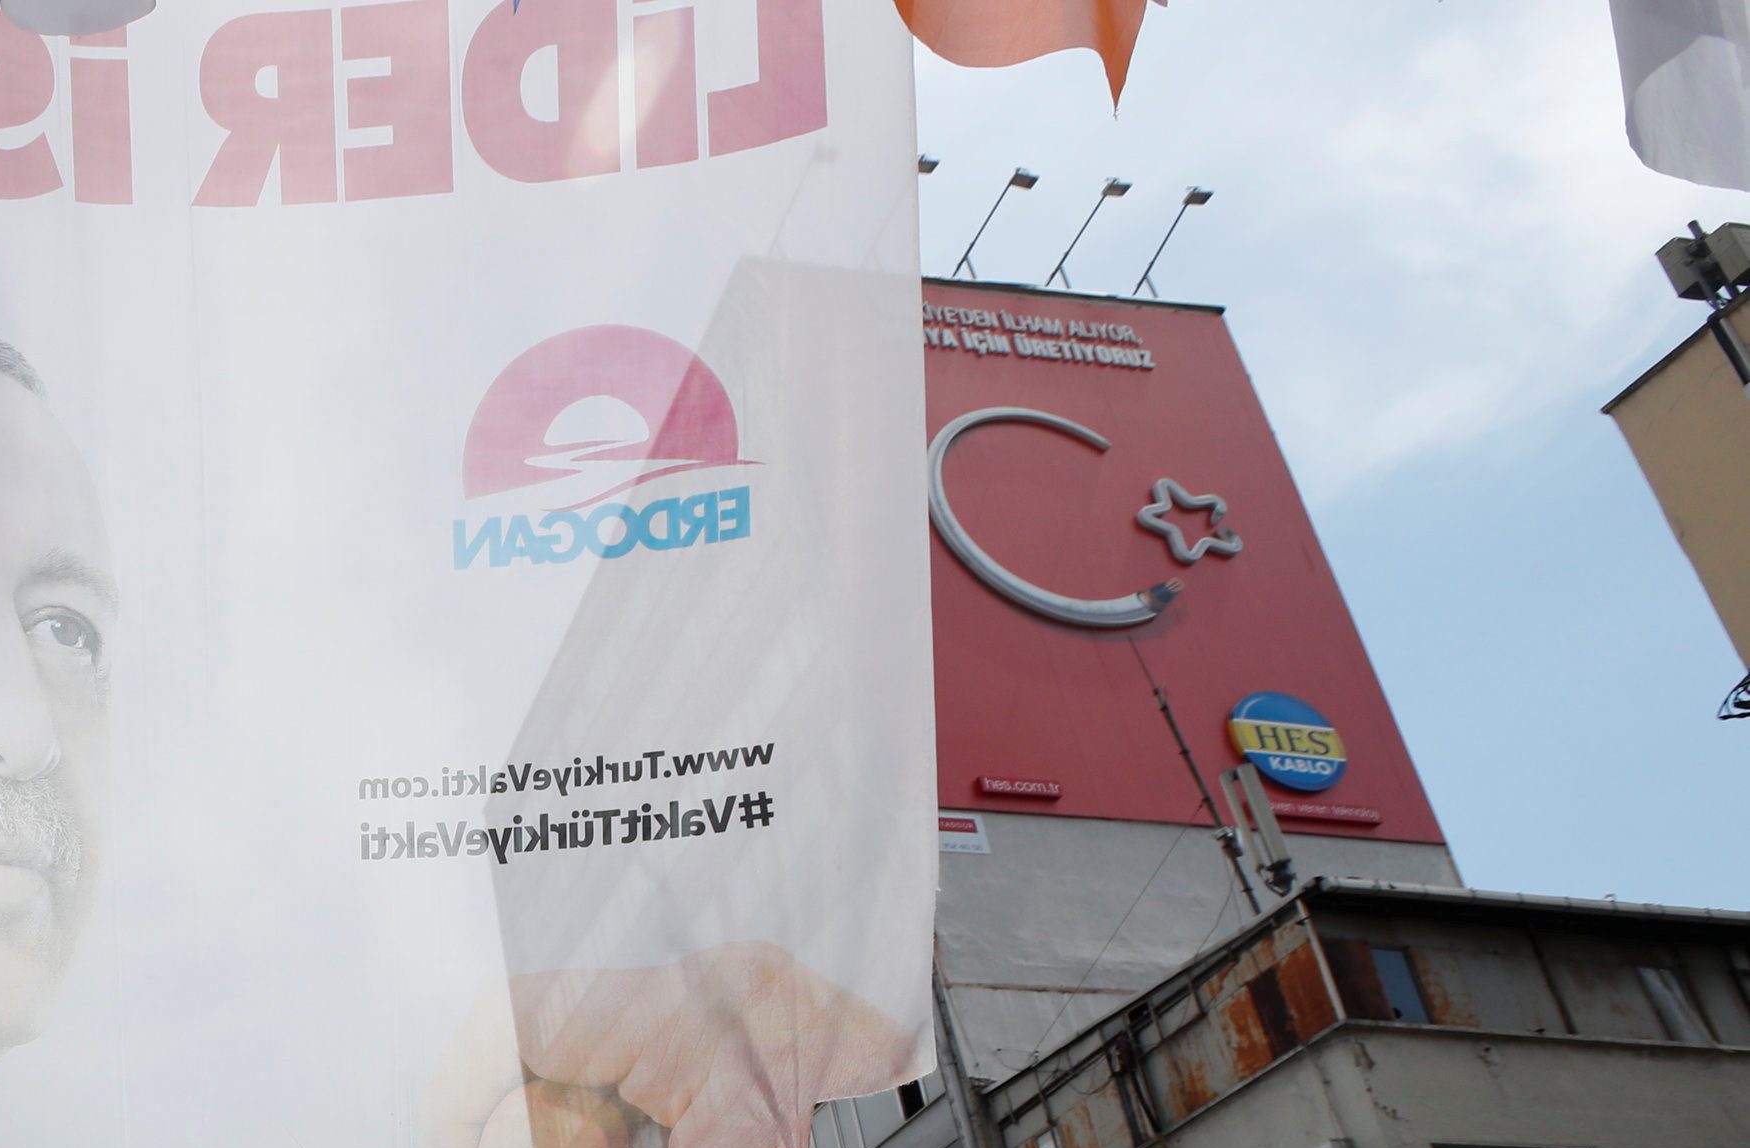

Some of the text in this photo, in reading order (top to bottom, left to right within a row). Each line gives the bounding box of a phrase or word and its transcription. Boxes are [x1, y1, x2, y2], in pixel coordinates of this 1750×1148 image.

[1001, 309, 1063, 336] İLHAM
[923, 326, 1156, 369] YA İÇİN ÜRETİYORUZ
[1254, 725, 1331, 756] HES
[1268, 756, 1333, 776] KABLO
[984, 777, 1061, 794] hes.com.tr
